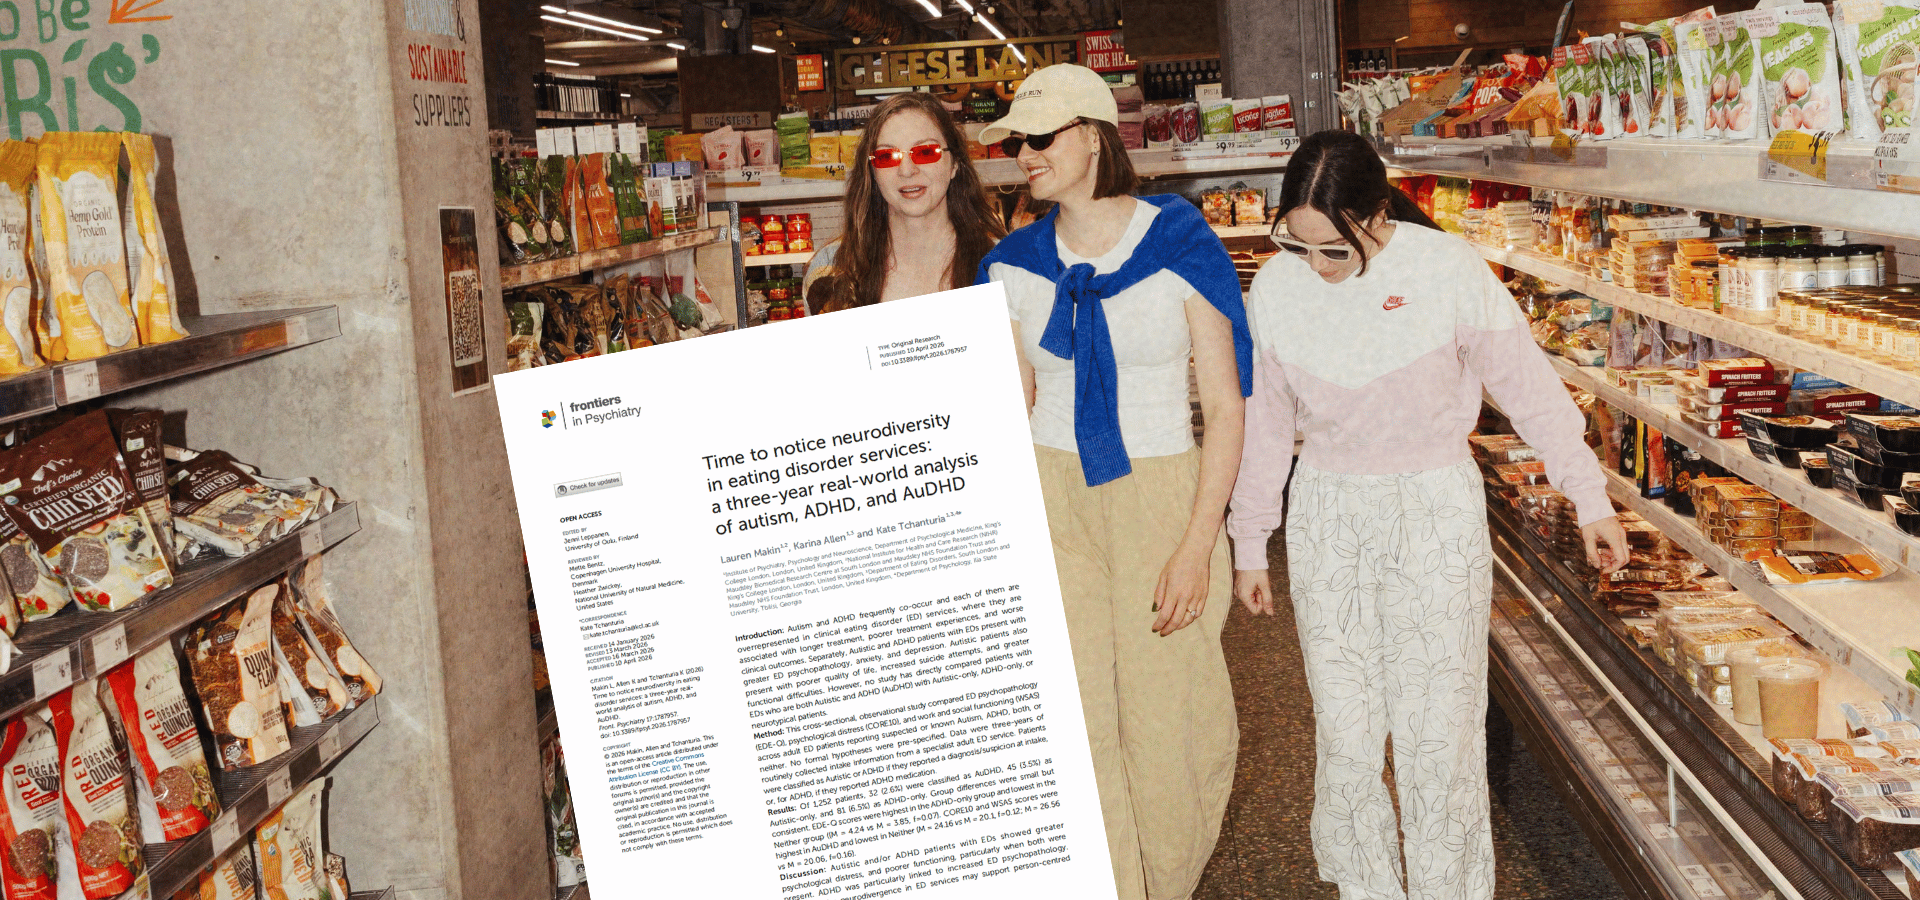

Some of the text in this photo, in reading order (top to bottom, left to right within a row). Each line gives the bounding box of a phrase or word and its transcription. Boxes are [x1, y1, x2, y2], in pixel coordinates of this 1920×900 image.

[1085, 35, 1113, 51] SWISS
[408, 43, 468, 84] SUSTAINABLE
[842, 42, 1072, 85] CHEESE LANE
[1480, 78, 1502, 87] FOX
[1472, 85, 1502, 105] POPS
[413, 93, 470, 127] SUPPLIERS
[841, 106, 873, 120] LASAGN
[1236, 111, 1260, 124] licorice
[1216, 141, 1235, 153] $9.99
[1280, 138, 1299, 150] $9.99
[825, 164, 845, 177] $4.50
[73, 198, 101, 207] ORGANIC
[69, 207, 112, 225] Hemp Gold
[77, 222, 107, 238] Protein
[1721, 372, 1762, 381] SPINACH FRITTERS
[1737, 389, 1777, 398] SPINACH FRITTERS
[1826, 400, 1866, 409] SPINACH FRITTERS
[22, 489, 69, 511] CERTIFIED
[68, 468, 109, 494] ORGANIC
[33, 468, 83, 496] Chef's Choice
[135, 472, 154, 491] CHIA
[193, 472, 240, 500] CHIA SEED
[28, 497, 83, 530] CHIA
[72, 475, 124, 510] SEED
[243, 649, 271, 679] QUIN
[157, 699, 190, 722] ORGANIC
[144, 708, 168, 742] RED
[162, 710, 195, 738] QUINOA
[83, 743, 118, 770] ORGANI
[27, 760, 60, 779] ORGAN
[71, 754, 94, 794] RED
[89, 755, 121, 786] QUINO
[13, 763, 38, 802] RED
[34, 774, 60, 792] QUIN
